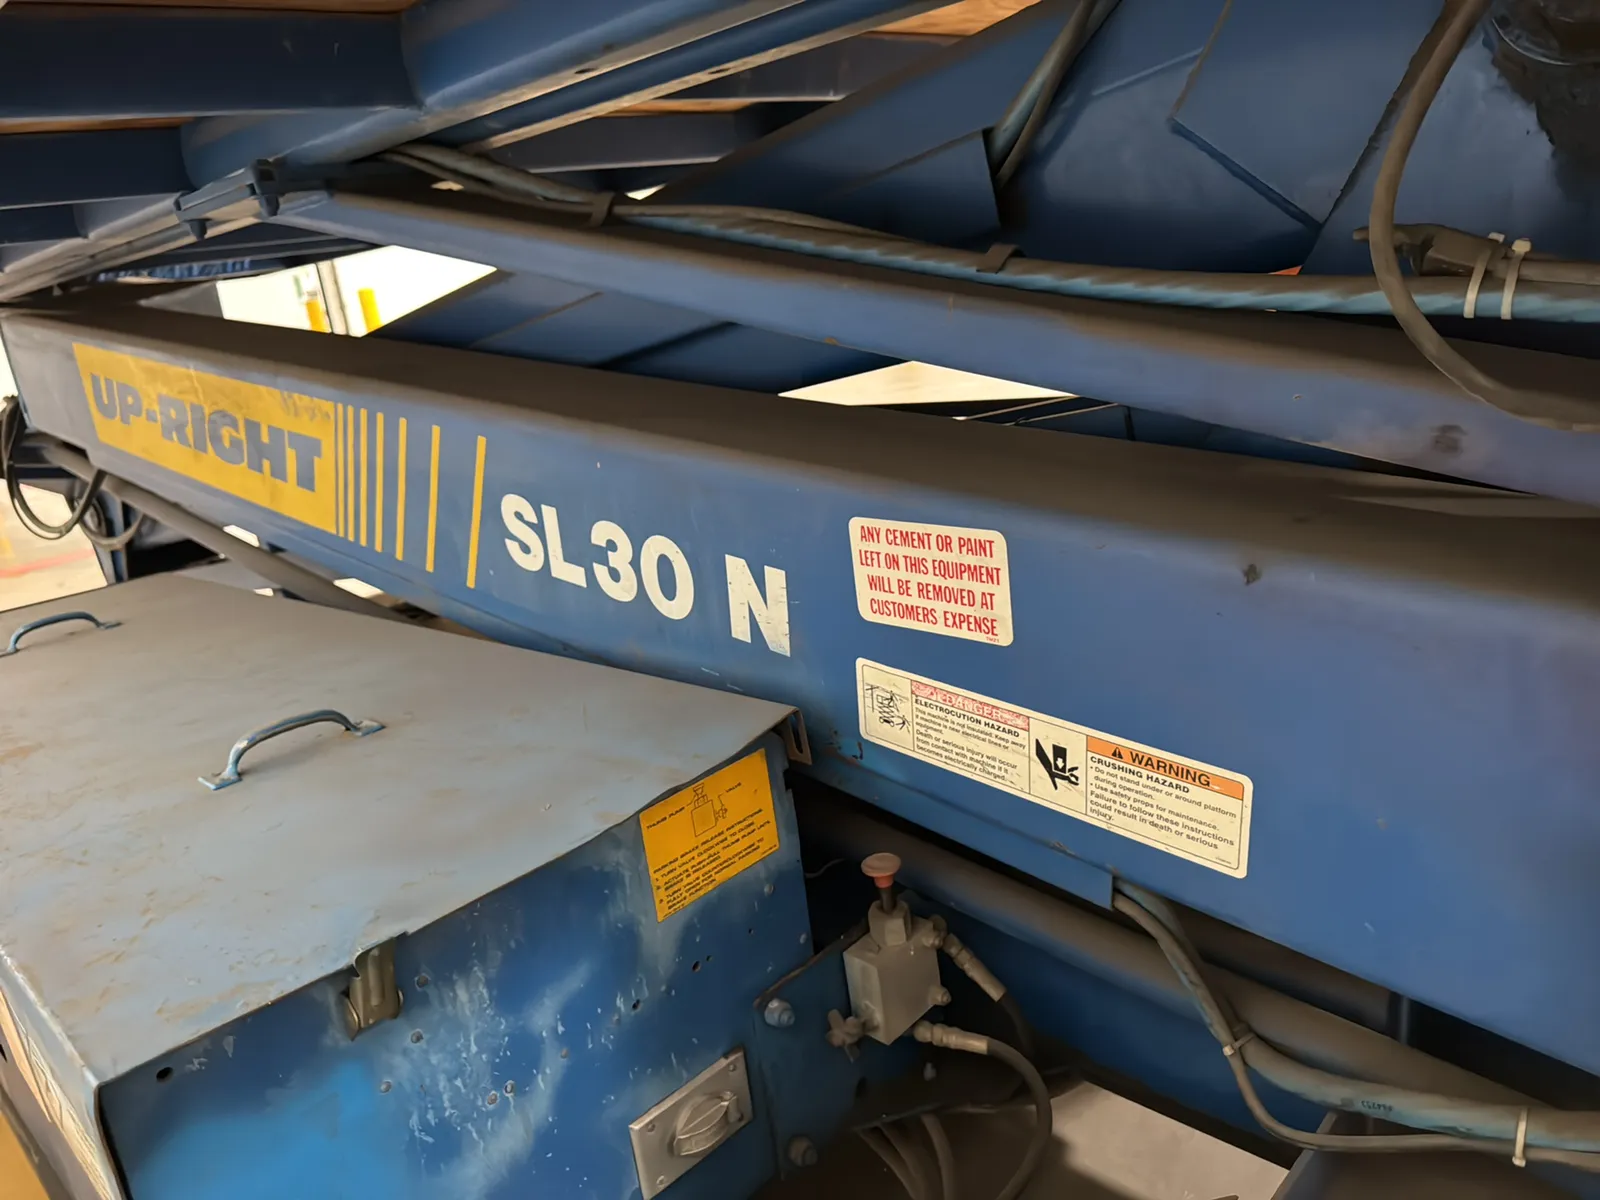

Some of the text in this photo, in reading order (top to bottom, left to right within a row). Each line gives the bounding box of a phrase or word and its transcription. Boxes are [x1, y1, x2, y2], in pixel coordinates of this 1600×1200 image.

[90, 372, 322, 492] UP-RIGHT
[860, 525, 995, 559] ANY CEMENT OR PAINT
[501, 493, 791, 657] SL30 N
[859, 549, 1001, 586] LEFT ON THIS EQUIPMENT
[867, 574, 996, 611] WILL BE REMOVED AT
[869, 597, 999, 637] CUSTOMERS EXPENSE
[915, 697, 1019, 738] ELECTROCUTION HAZARD
[915, 707, 926, 715] This
[927, 711, 949, 723] machine
[956, 720, 965, 728] not
[994, 733, 1009, 744] Keep
[1010, 739, 1025, 749] away
[920, 715, 941, 727] machine
[948, 725, 960, 733] near
[961, 729, 986, 742] electrical
[988, 738, 1001, 747] lines
[916, 729, 933, 740] Death
[942, 738, 964, 751] serious
[966, 746, 984, 759] injury
[985, 753, 996, 762] will
[998, 758, 1017, 770] occur
[916, 736, 930, 746] from
[931, 741, 953, 754] contact
[955, 750, 967, 759] with
[969, 755, 996, 769] machine
[916, 743, 943, 758] becomes
[944, 753, 977, 772] electrically
[1130, 751, 1211, 787] WARNING
[1090, 755, 1190, 794] CRUSHING HAZARD
[1094, 774, 1155, 801] during operation.
[1095, 766, 1236, 820] Do not stand under or around platform
[647, 807, 685, 830] THUMB PUMP
[1090, 806, 1114, 822] injury.
[1090, 789, 1234, 846] Failure to follow these instructions
[1090, 798, 1218, 849] could result in death or serious
[1094, 783, 1219, 831] Use safety props for maintenance.
